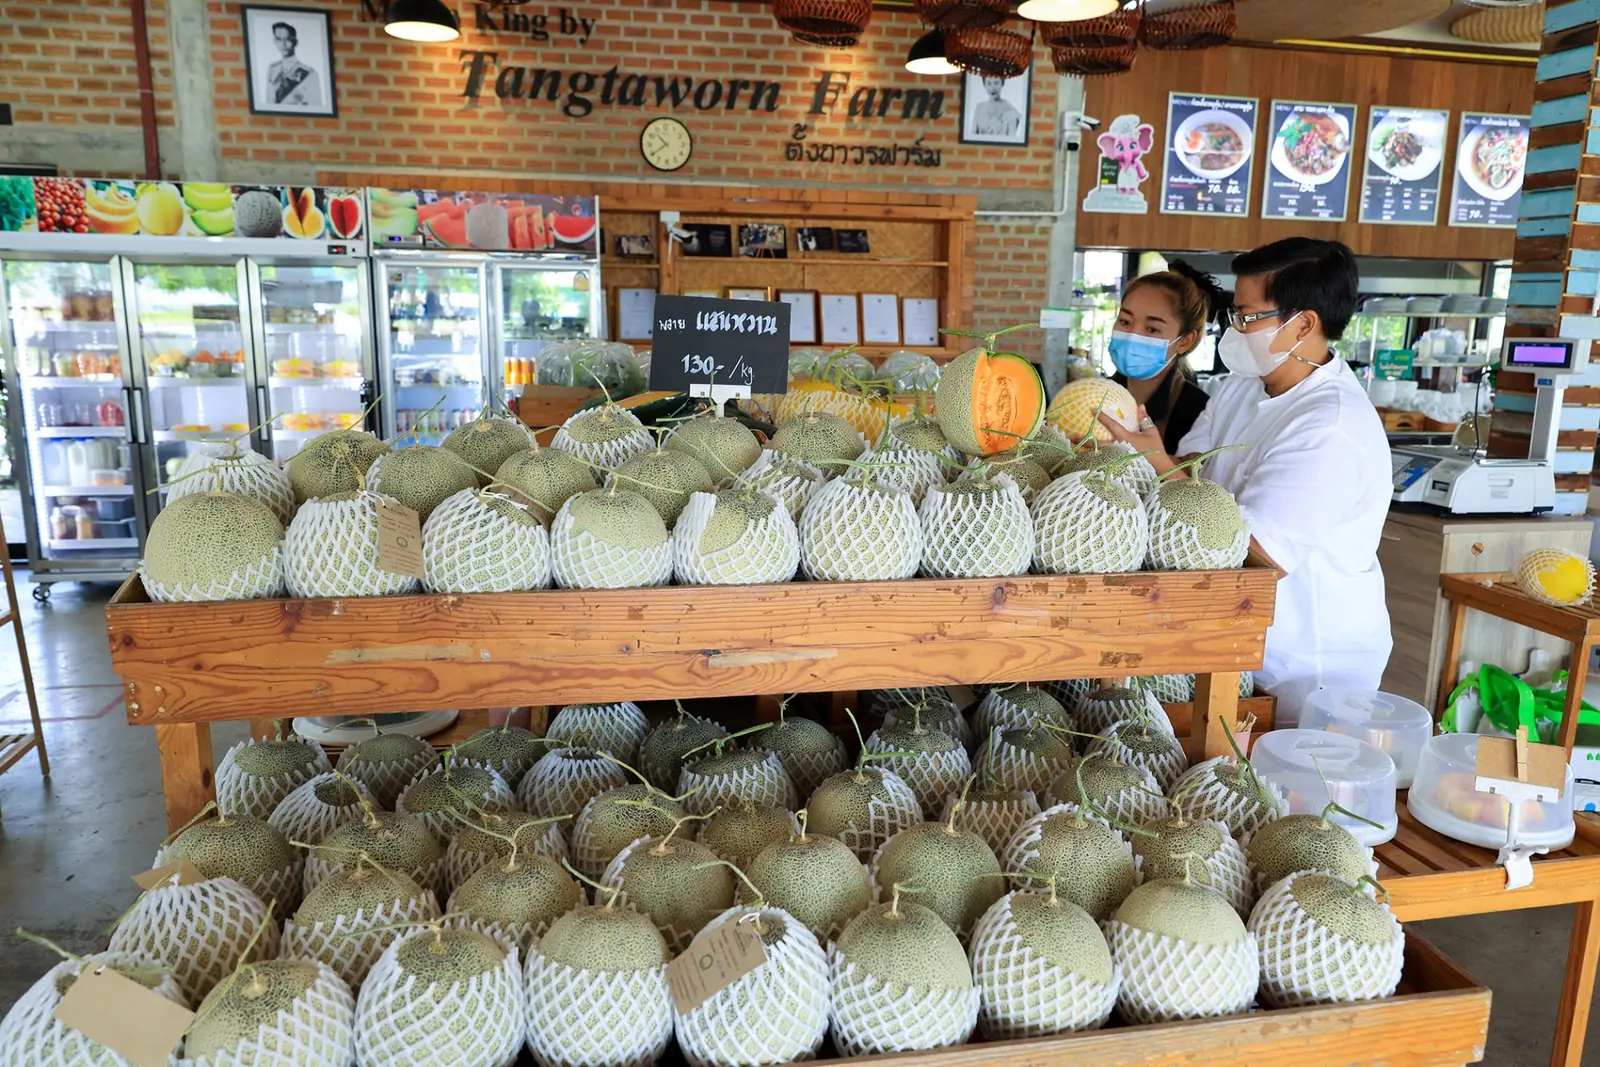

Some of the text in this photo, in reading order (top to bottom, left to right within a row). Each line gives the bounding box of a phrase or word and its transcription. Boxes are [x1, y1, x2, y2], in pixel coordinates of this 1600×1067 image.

[475, 3, 549, 42] King
[560, 8, 595, 44] by
[459, 50, 945, 120] Tangtaworn Farm
[695, 310, 778, 336] แสนหวาน
